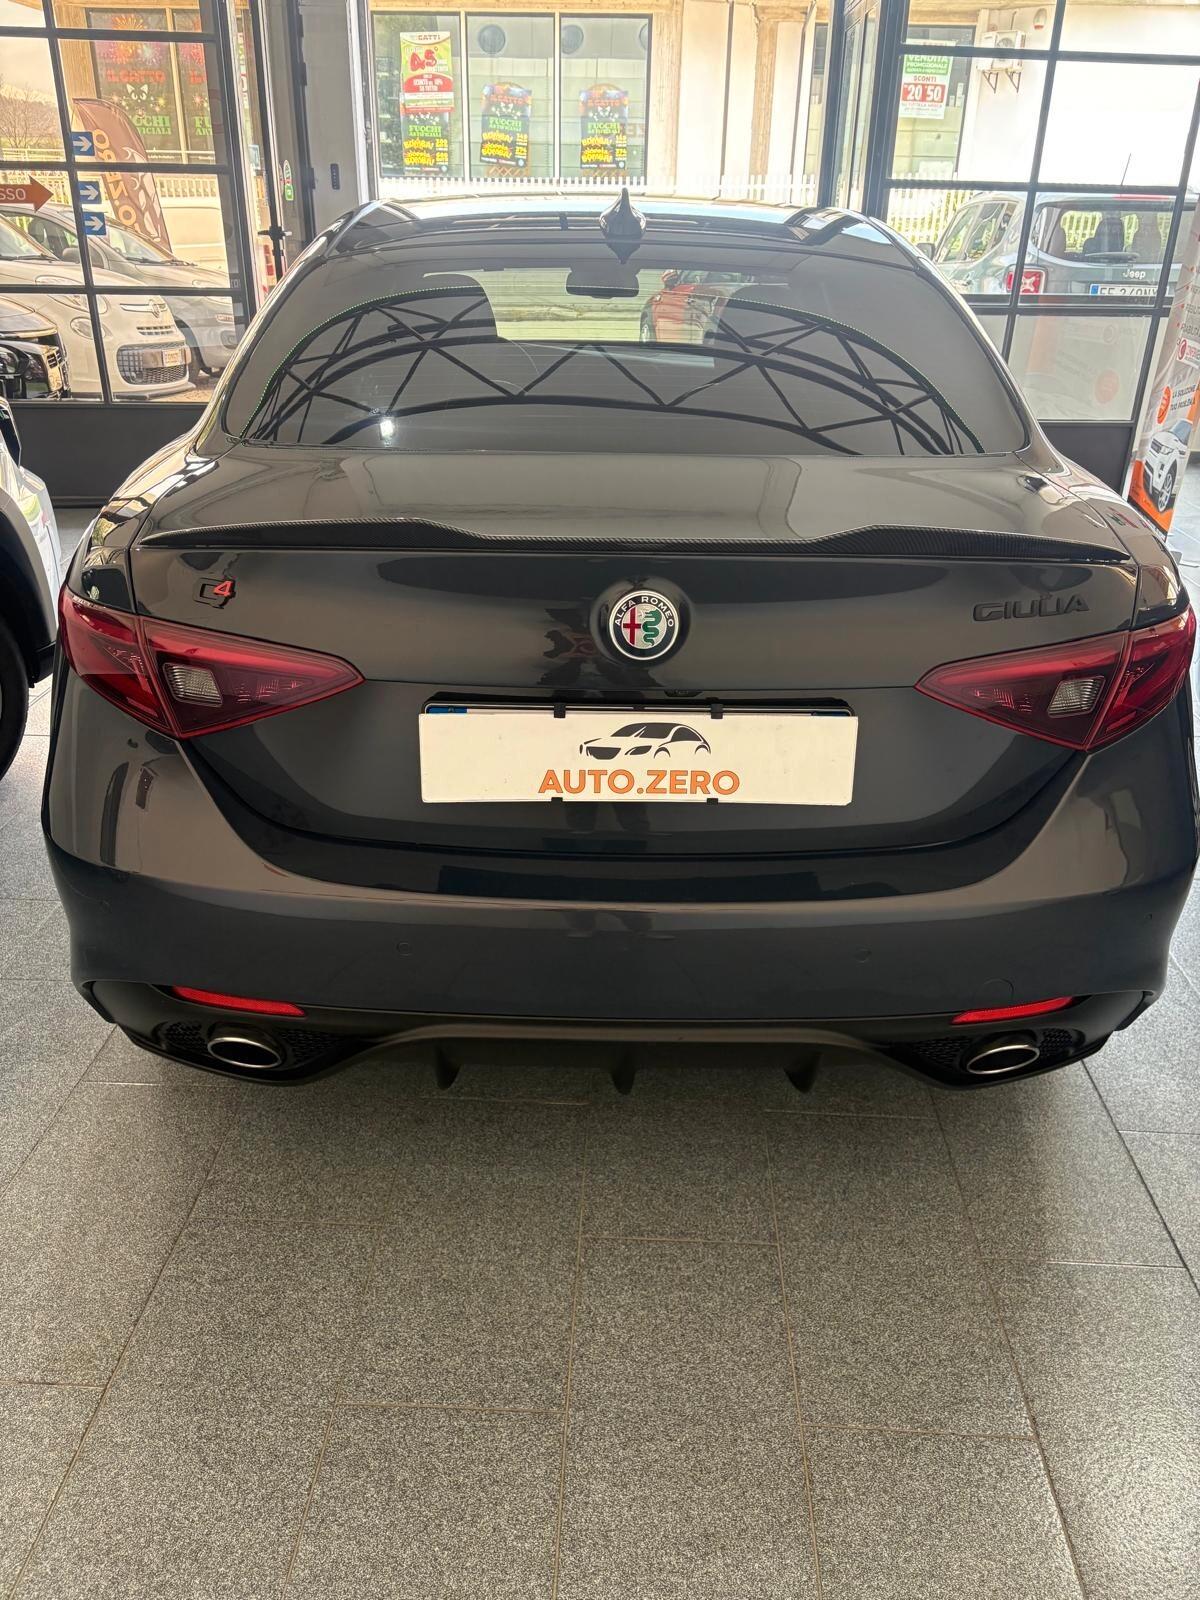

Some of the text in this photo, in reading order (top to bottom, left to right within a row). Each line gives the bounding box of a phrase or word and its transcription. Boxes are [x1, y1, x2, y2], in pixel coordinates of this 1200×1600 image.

[907, 85, 942, 101] 20 50
[133, 115, 170, 127] OCHI
[1123, 268, 1146, 279] Jeep
[614, 596, 675, 627] ALFA ROMEO
[972, 594, 1090, 621] GIULIA
[537, 769, 741, 796] AUTO.ZERO
